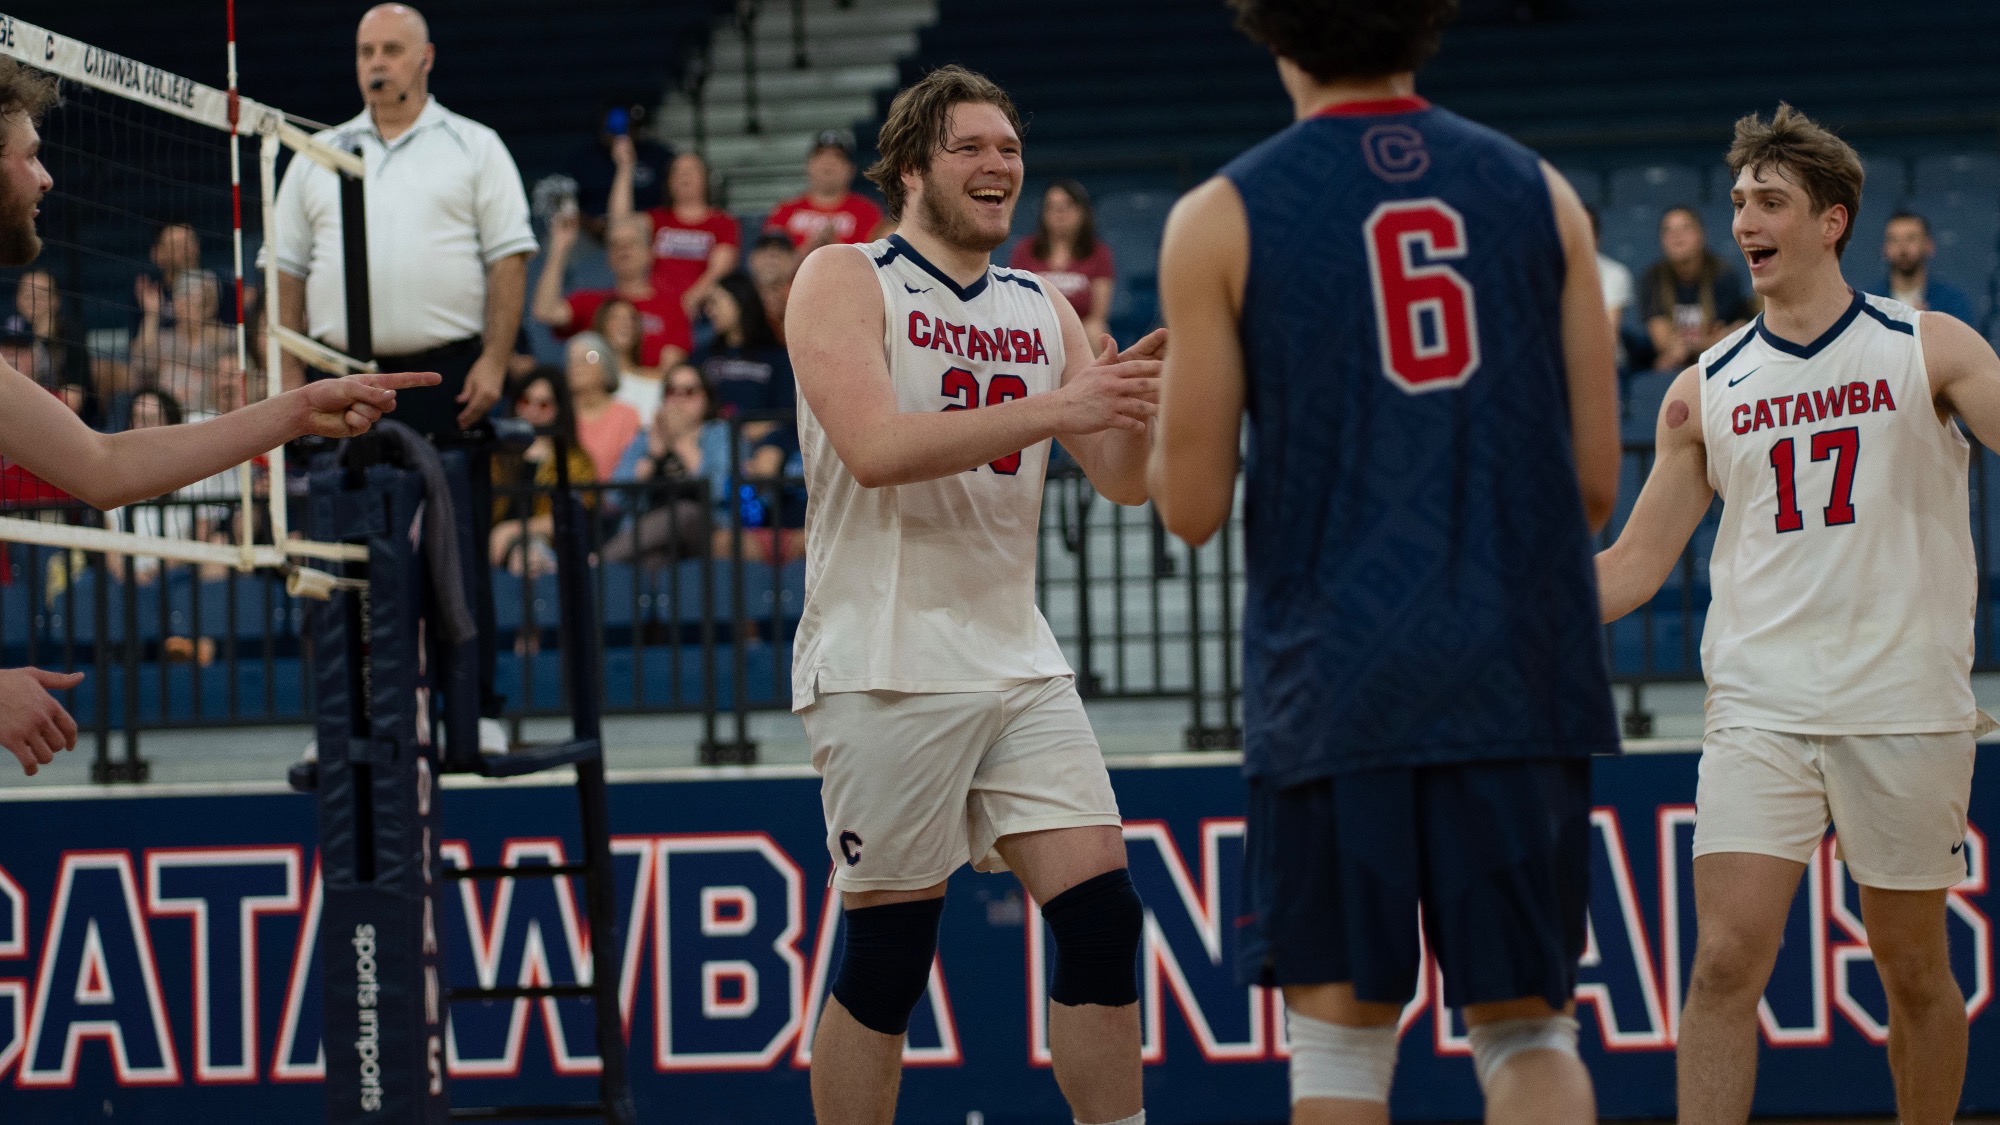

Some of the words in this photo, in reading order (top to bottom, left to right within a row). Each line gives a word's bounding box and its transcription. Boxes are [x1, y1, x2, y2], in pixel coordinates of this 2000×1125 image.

[1361, 124, 1431, 183] C
[908, 310, 1050, 365] CATAWBA
[1363, 199, 1482, 396] 6
[1732, 379, 1896, 435] CATAWBA
[1769, 426, 1860, 534] 17
[839, 829, 863, 867] C
[0, 831, 964, 1086] ATWB
[351, 923, 381, 1007] sports
[354, 1009, 384, 1112] imports
